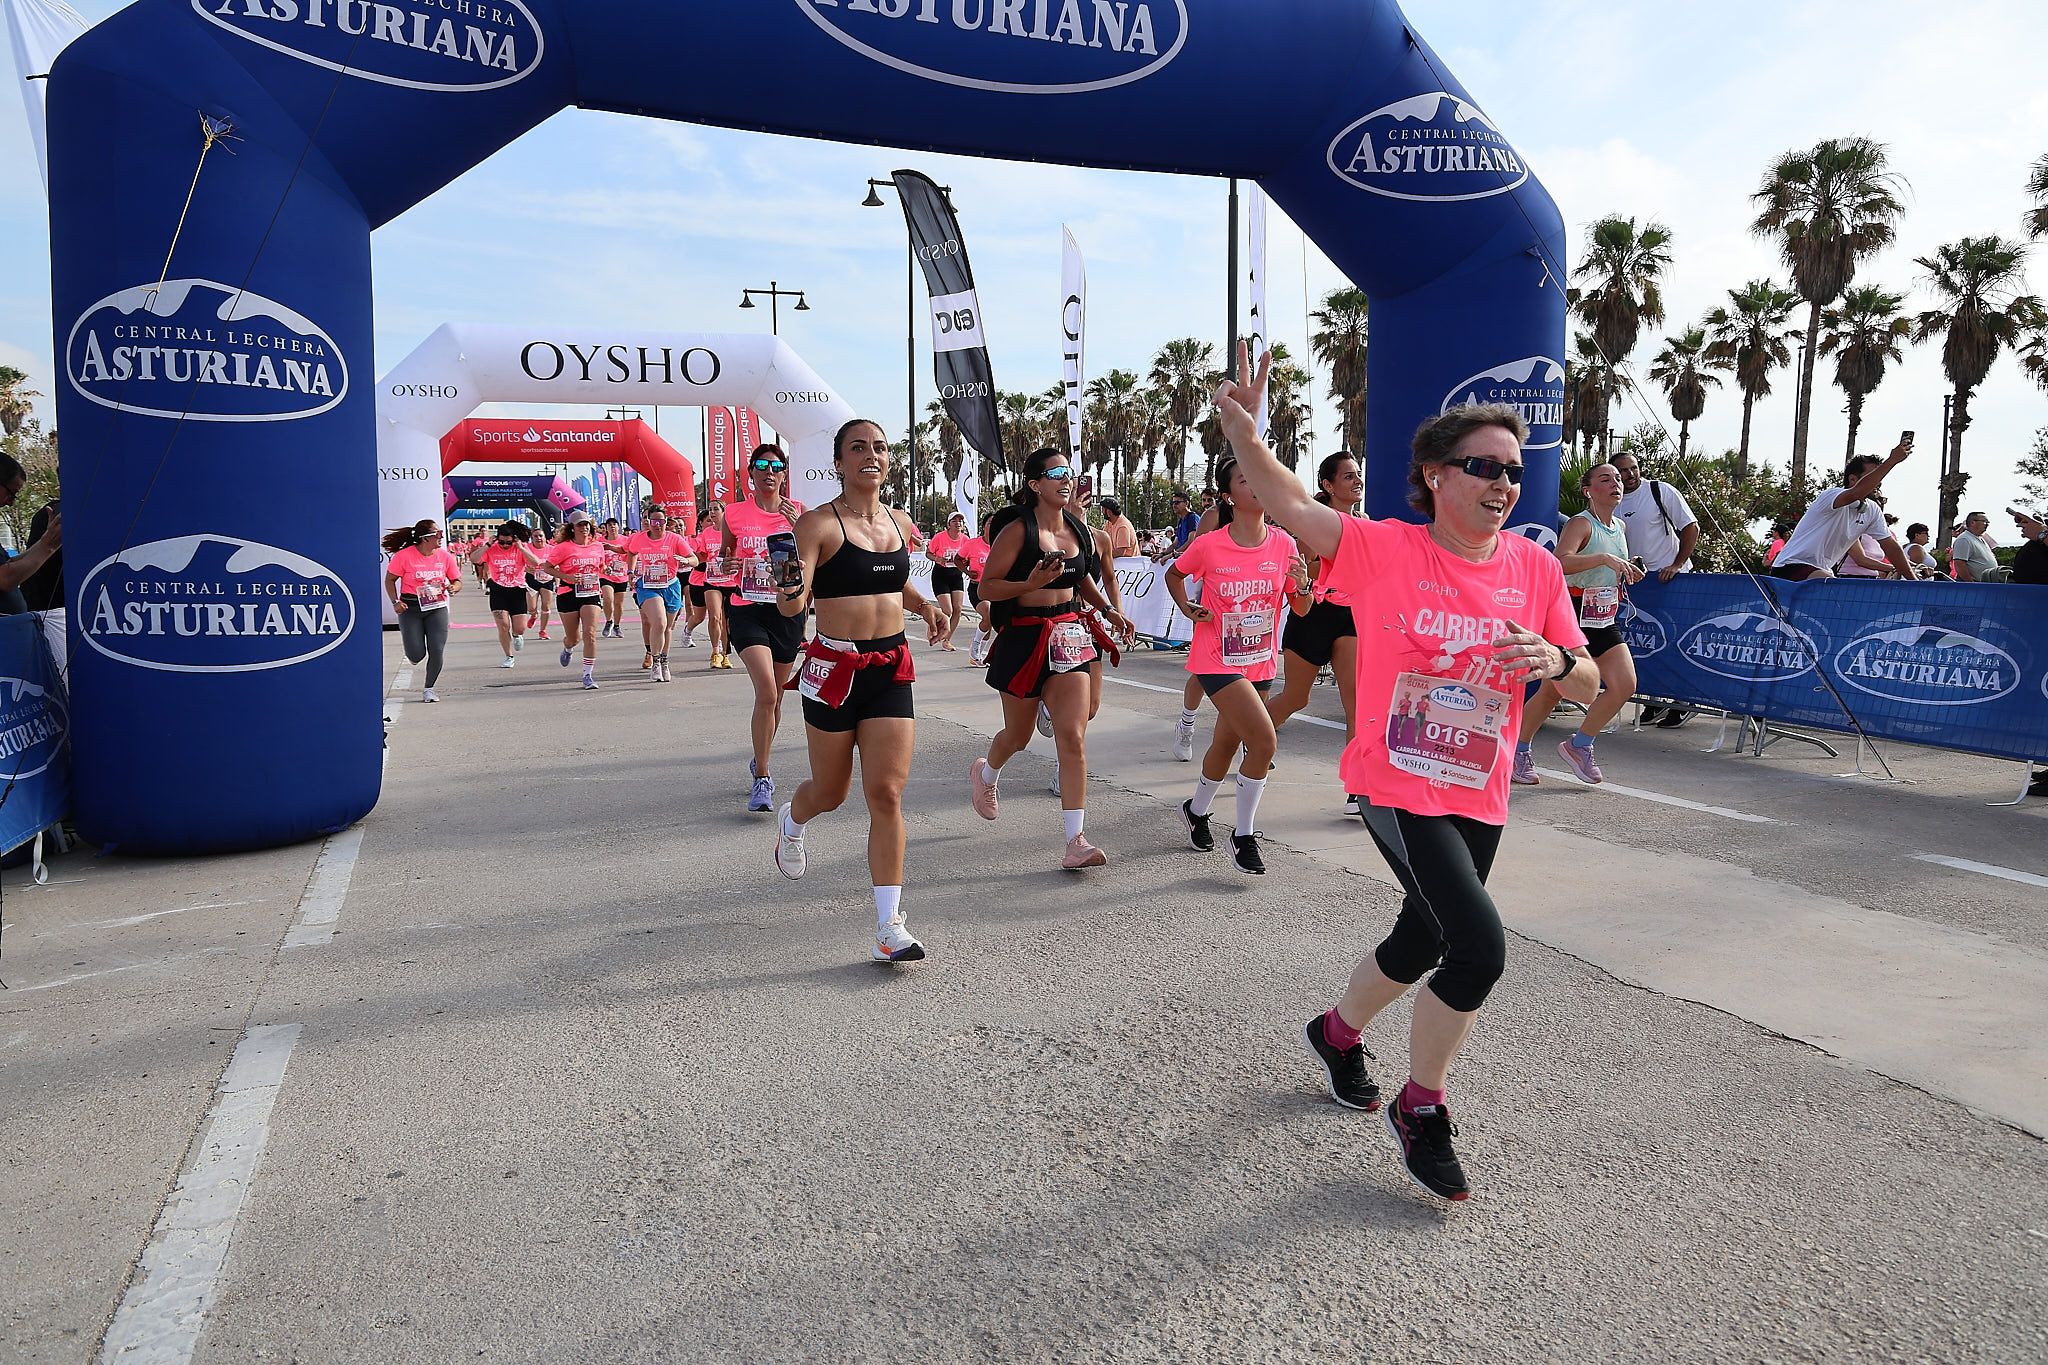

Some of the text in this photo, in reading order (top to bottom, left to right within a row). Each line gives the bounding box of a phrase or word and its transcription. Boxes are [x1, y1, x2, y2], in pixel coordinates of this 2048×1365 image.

[413, 0, 515, 26] CHERA
[214, 0, 518, 71] STURIANA
[813, 0, 1158, 56] TURIANA
[1388, 128, 1457, 140] CENTRAL
[1344, 132, 1523, 173] ASTURIANA
[114, 324, 326, 356] CENTRAL LECHERA
[79, 329, 335, 398] ASTURIANA
[520, 341, 721, 386] OYSHO
[391, 384, 458, 399] OYSHO
[775, 391, 829, 404] OYSHO
[1489, 388, 1544, 398] CENTRAL
[473, 428, 616, 445] Sports Santander
[378, 467, 429, 481] YSHO
[805, 468, 841, 481] OYS
[742, 536, 768, 549] CARR
[125, 581, 333, 597] CENTRAL LECHERA
[1220, 579, 1274, 597] CARRERA
[89, 583, 341, 637] ASTURIANA
[1597, 605, 1611, 613] 016
[1413, 608, 1509, 646] CARRER
[1243, 635, 1262, 646] 016
[1710, 632, 1752, 643] CENTRAL
[1065, 646, 1081, 656] 016
[1686, 632, 1804, 669] ASTURIANA
[1876, 649, 2000, 667] CENTRAL LECHERA
[810, 662, 830, 679] 016
[1844, 648, 2001, 691] ASTURIANA
[0, 712, 64, 760] STURIANA
[1425, 722, 1469, 747] 016
[1396, 745, 1421, 755] CARRERA
[1422, 750, 1429, 758] DE
[1434, 744, 1455, 755] 2213
[1397, 756, 1477, 782] OYSHO Santander
